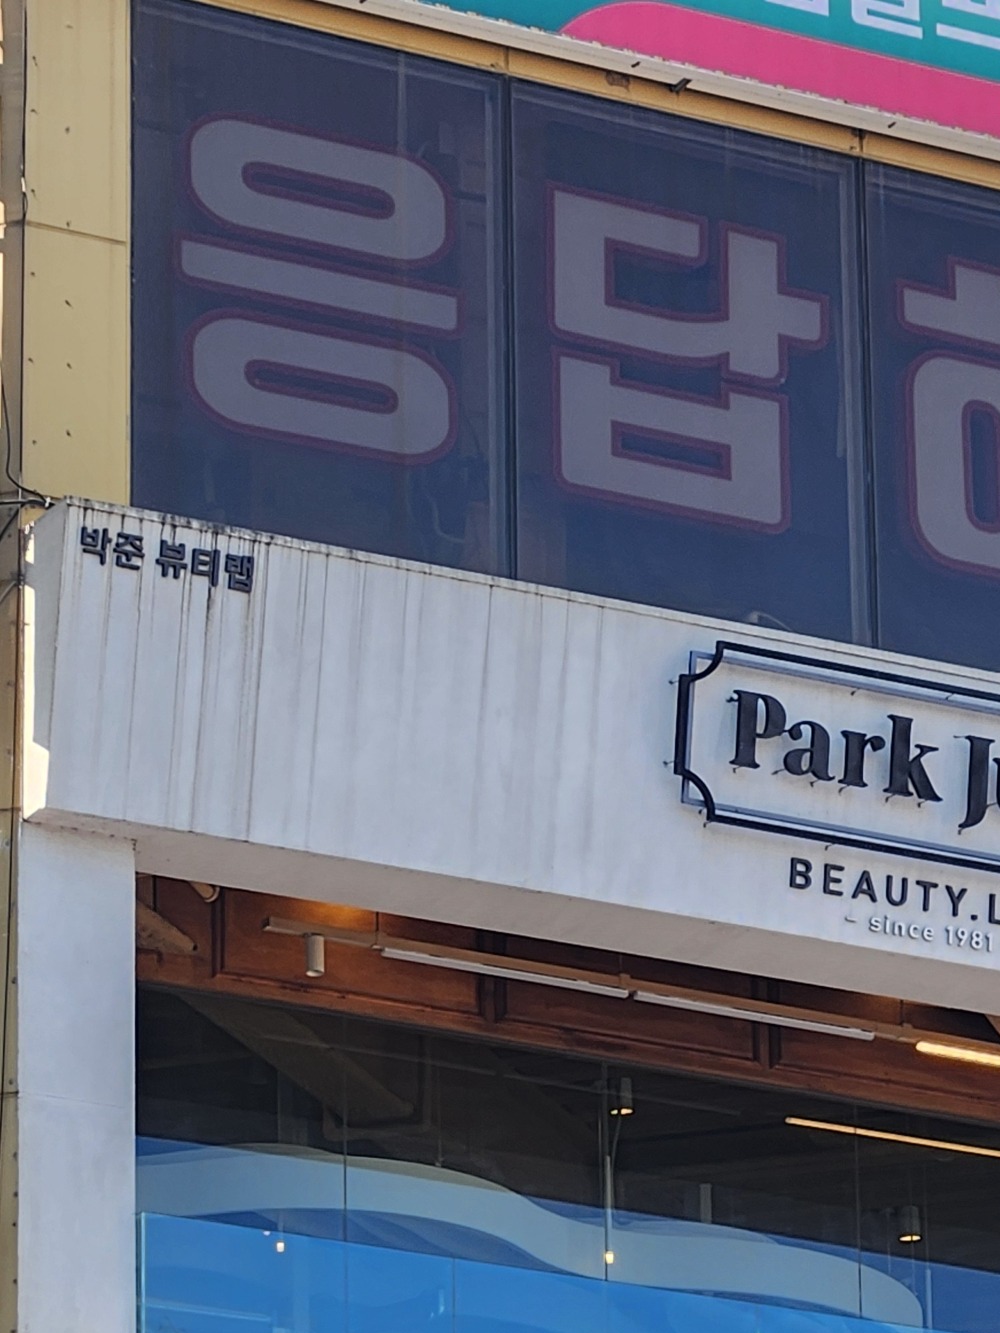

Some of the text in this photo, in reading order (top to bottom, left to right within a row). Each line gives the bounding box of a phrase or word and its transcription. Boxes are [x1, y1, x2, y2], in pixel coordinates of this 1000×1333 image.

[80, 526, 255, 593] 박준 뷰티랩
[729, 689, 943, 802] Park
[868, 915, 993, 953] since 1981
